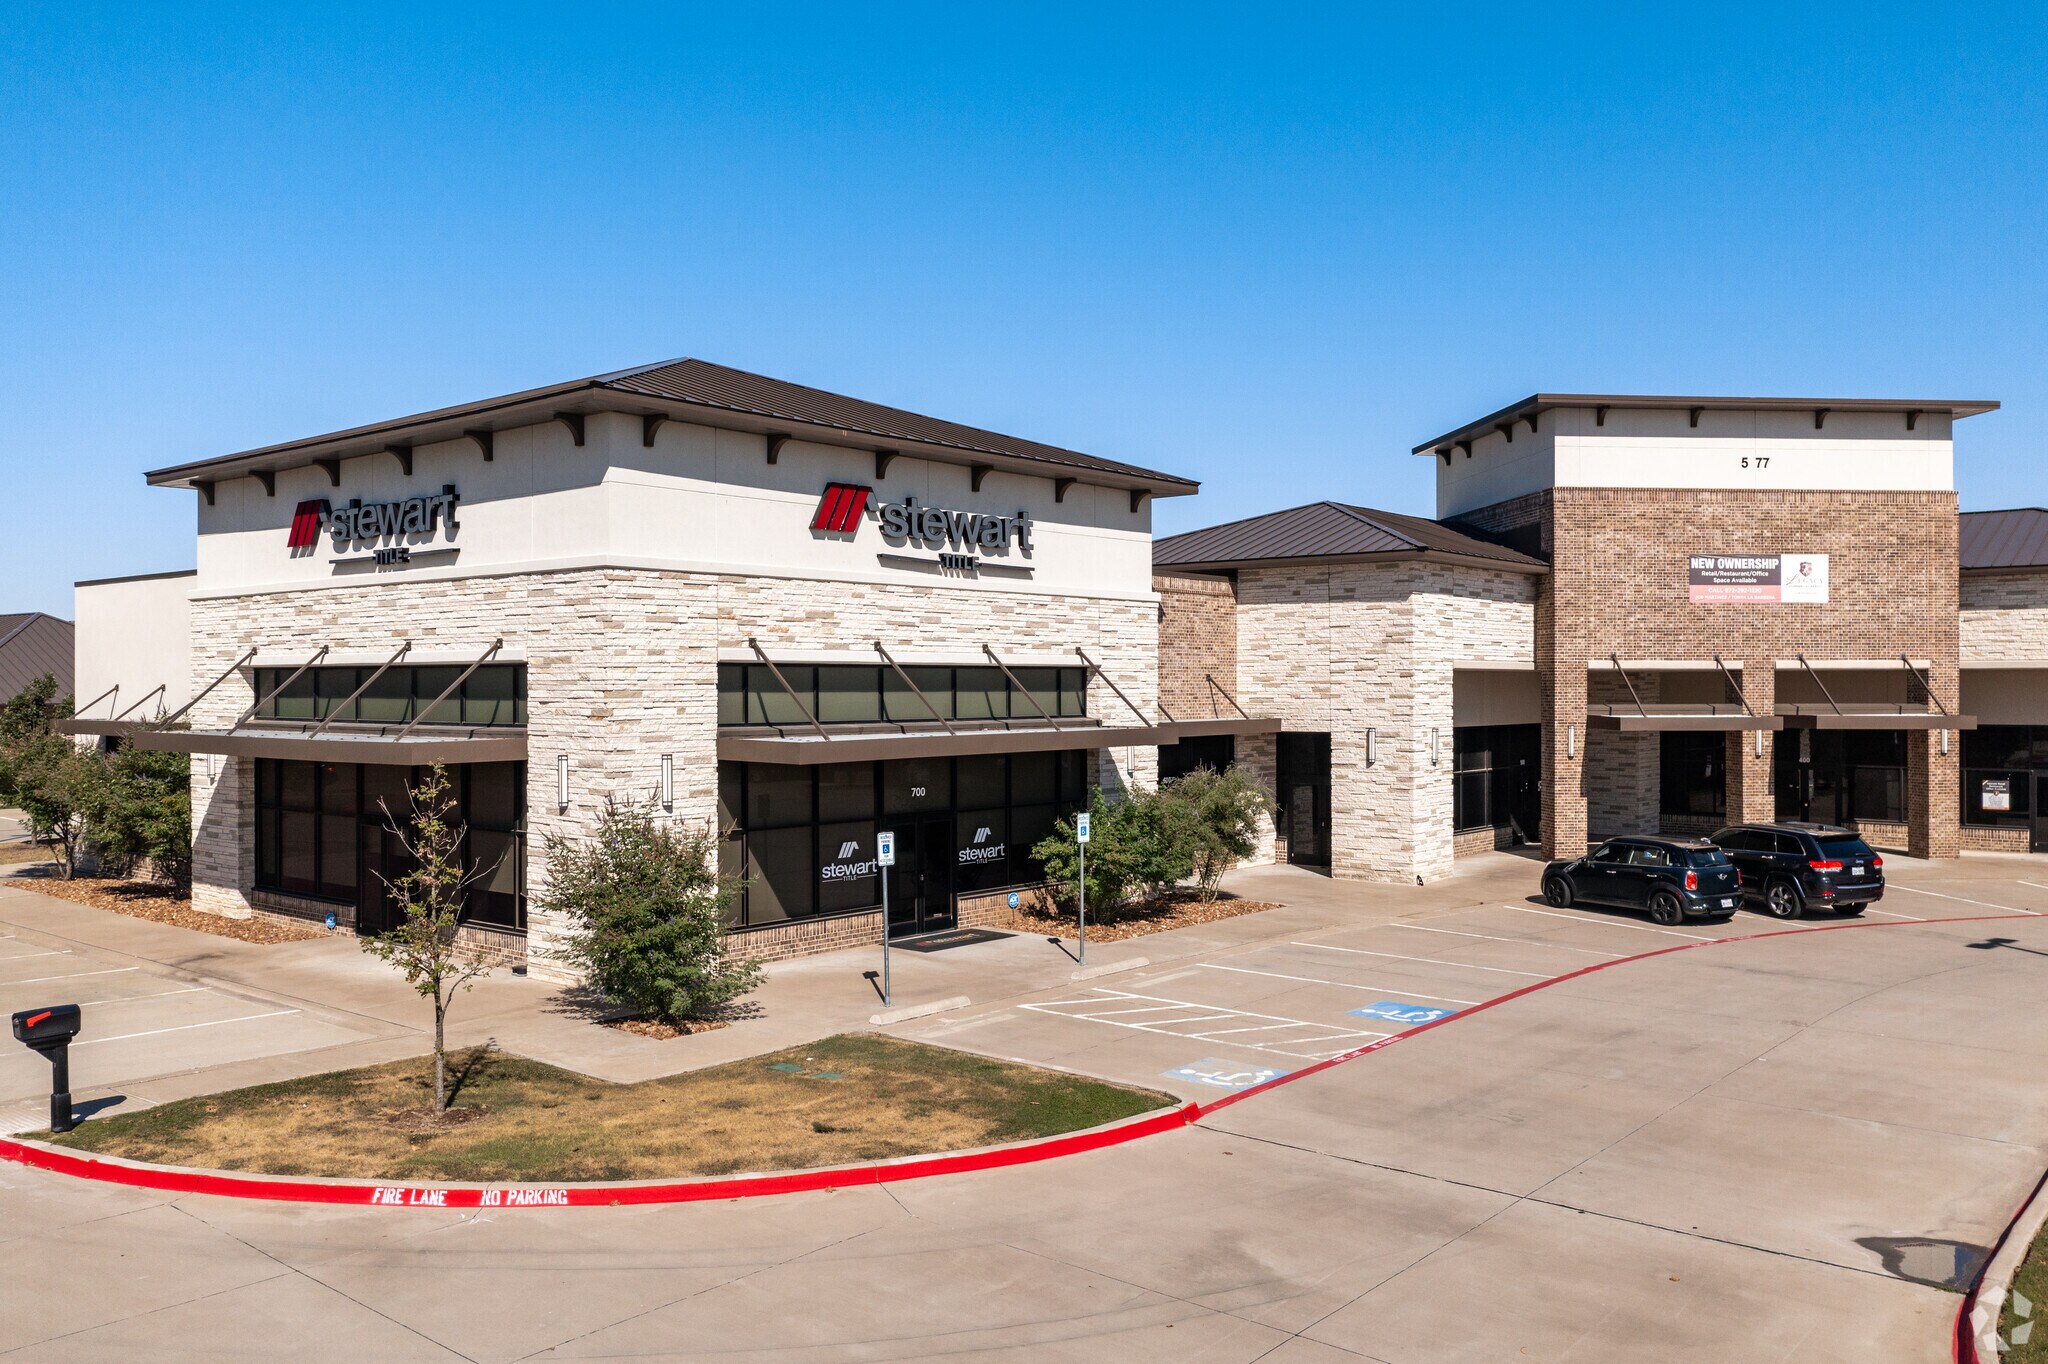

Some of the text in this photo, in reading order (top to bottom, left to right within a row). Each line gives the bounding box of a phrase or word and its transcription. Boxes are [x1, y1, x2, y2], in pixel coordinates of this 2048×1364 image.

[1755, 457, 1770, 469] 77
[330, 484, 460, 543] stewart
[882, 497, 1034, 550] stewart
[374, 547, 409, 565] TITLE
[941, 553, 980, 571] TITLE
[1690, 557, 1779, 570] NEW OWNERSHIP
[911, 787, 926, 797] 700
[958, 843, 1005, 862] stewart
[821, 858, 878, 879] stewart
[371, 1187, 568, 1207] FIRE LANE NO PARKING
